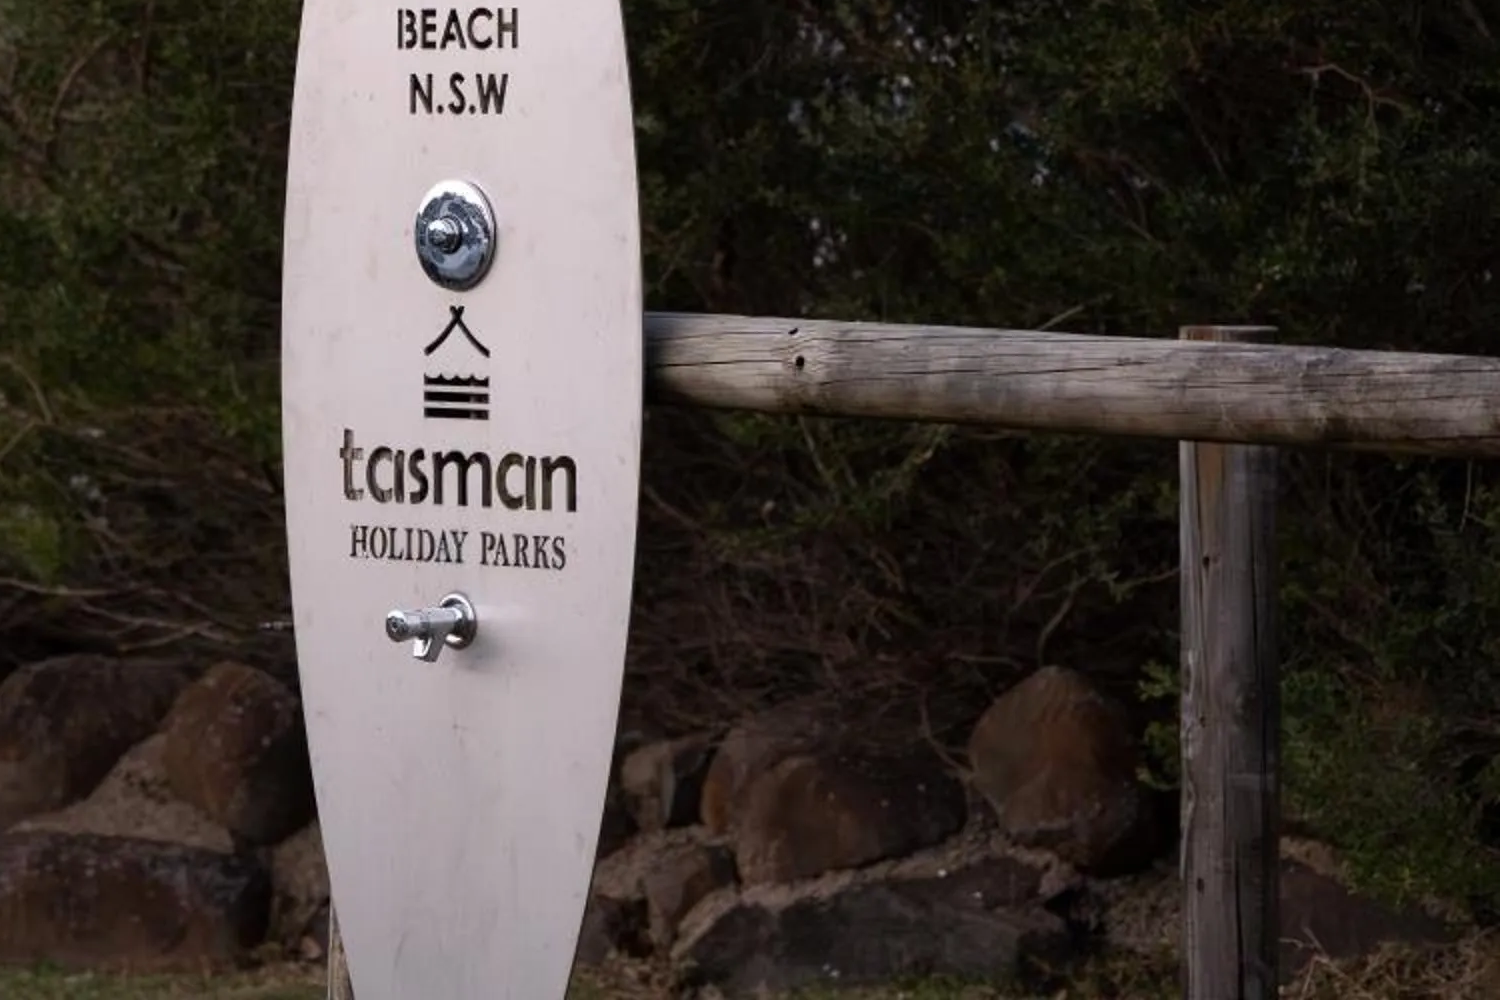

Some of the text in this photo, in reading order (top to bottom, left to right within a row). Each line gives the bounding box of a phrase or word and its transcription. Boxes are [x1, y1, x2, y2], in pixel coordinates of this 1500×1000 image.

[397, 7, 519, 51] BEACH
[409, 72, 509, 116] N.S.W
[339, 428, 578, 513] tasman
[350, 525, 567, 571] HOLIDAY PARKS
